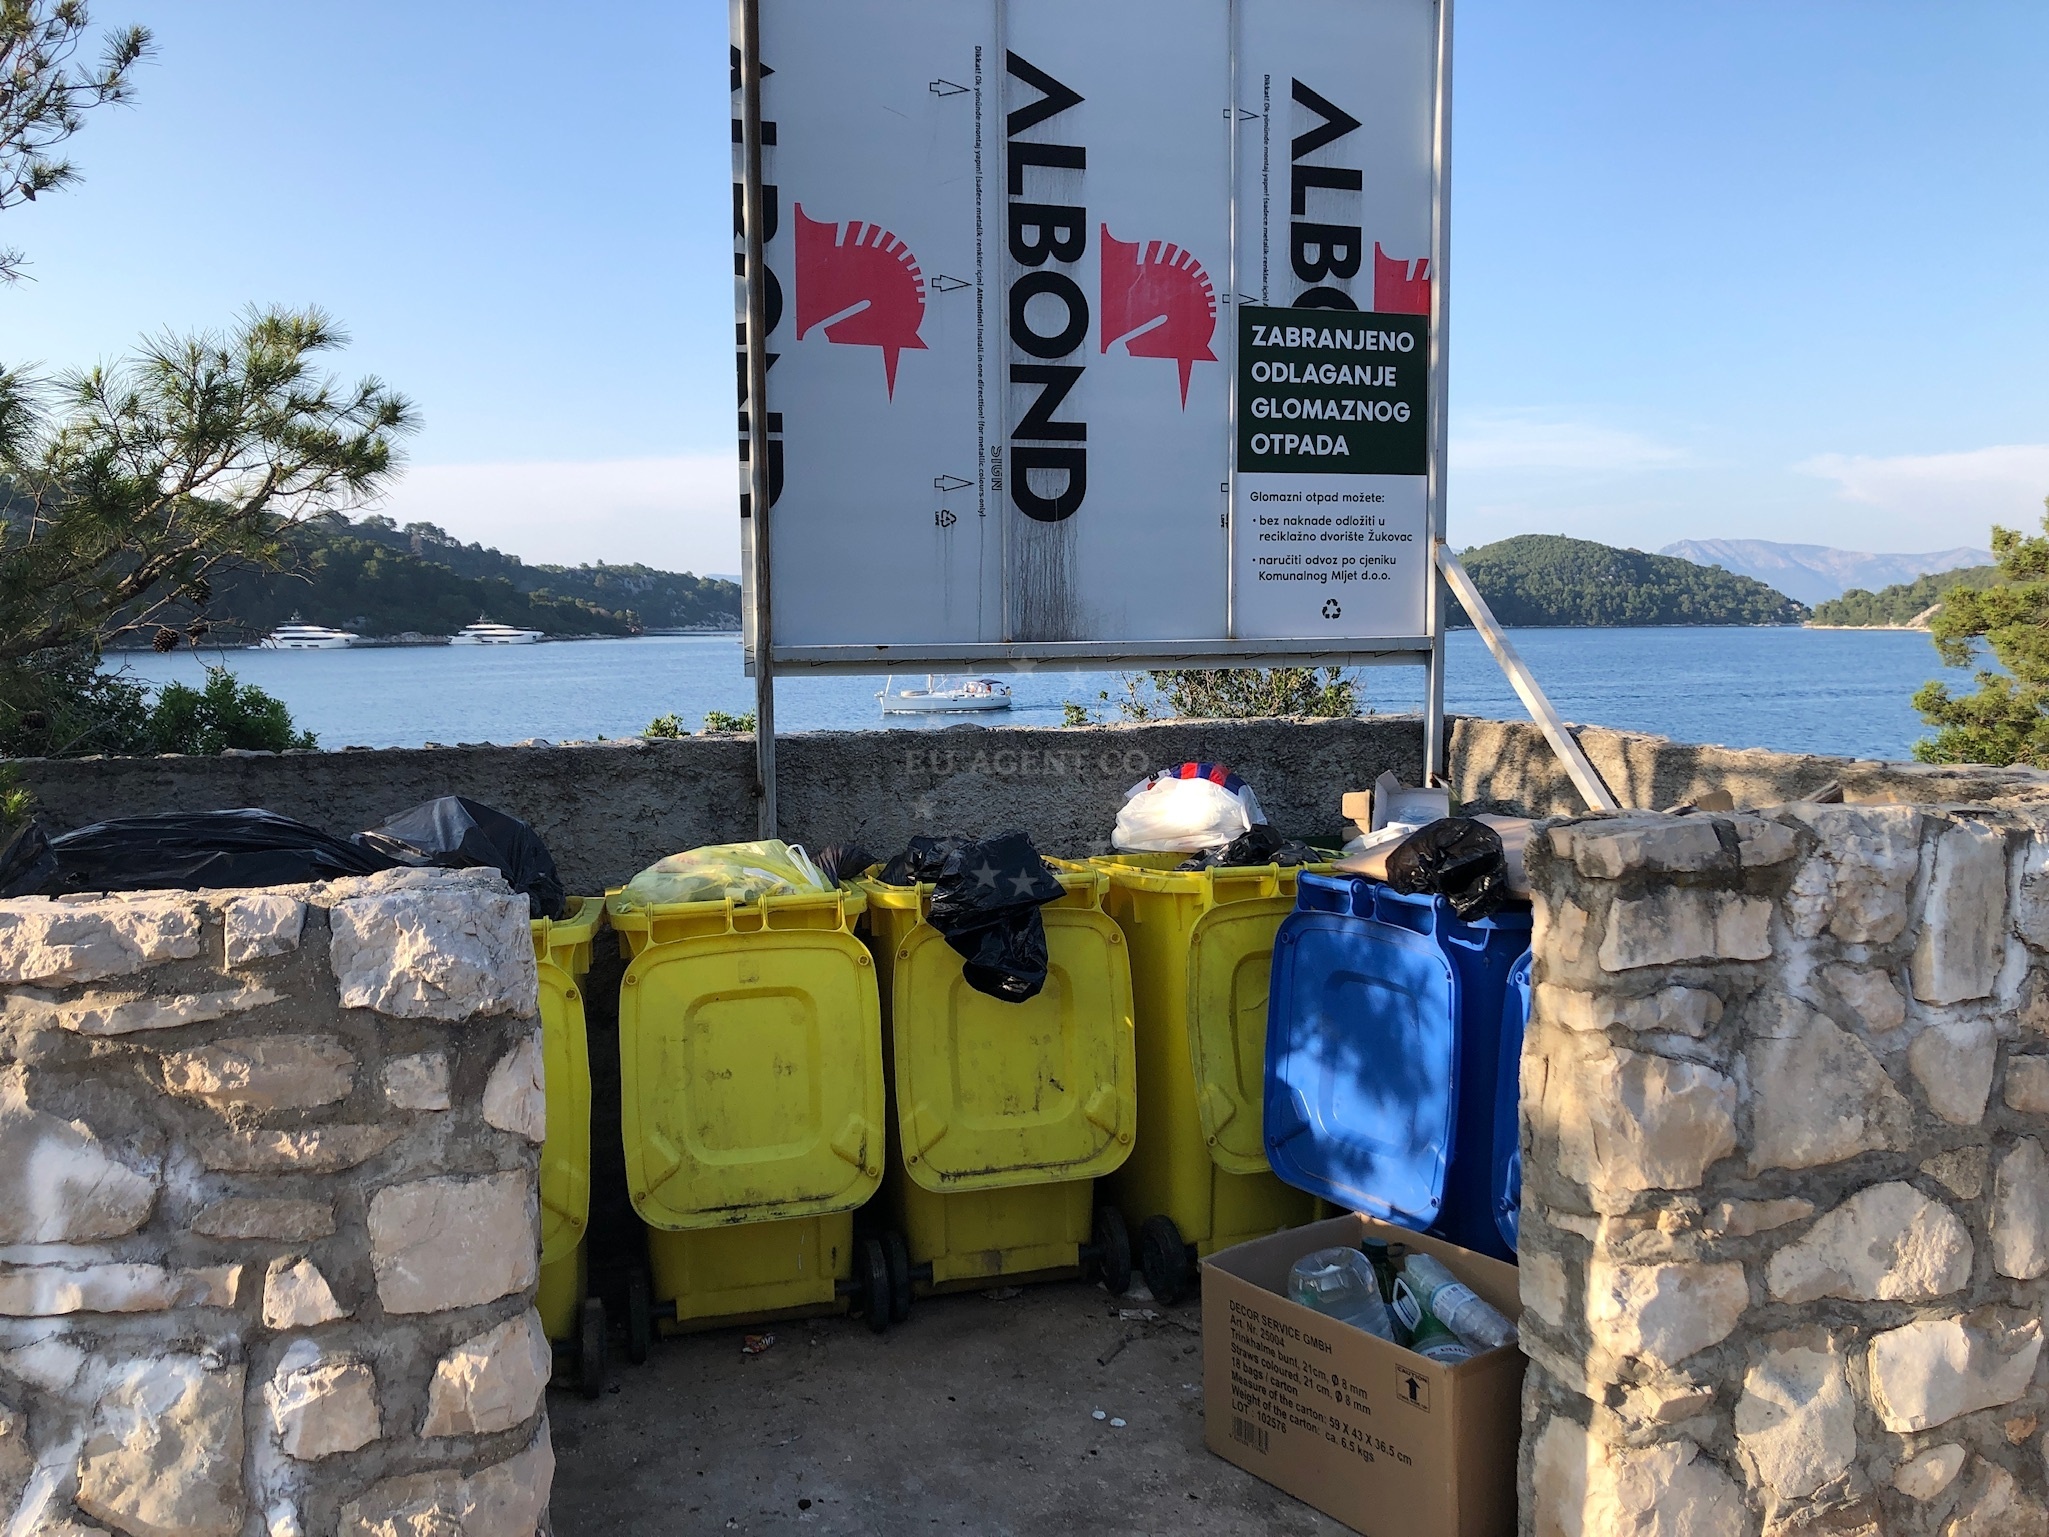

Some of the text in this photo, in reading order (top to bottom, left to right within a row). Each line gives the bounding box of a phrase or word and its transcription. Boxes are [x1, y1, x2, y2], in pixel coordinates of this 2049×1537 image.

[974, 122, 982, 149] montaj
[1291, 77, 1362, 311] ALB
[1006, 49, 1089, 522] ALBOND
[1251, 325, 1415, 352] ZABRANJENO
[1251, 361, 1397, 387] ODLAGANJE
[1251, 397, 1411, 422] GLOMAZNOG
[1250, 433, 1350, 456] OTPADA
[991, 445, 1002, 491] SIGN
[1250, 491, 1385, 505] Glomazni otpad možete:
[1259, 515, 1385, 526] bez naknade odložiti u
[1259, 529, 1413, 542] reciklažno dvorište Žukovac
[1259, 554, 1397, 568] naručiti odvoz po cjeniku
[1258, 570, 1391, 584] Komunalnog Mljet d.o.o.
[1229, 1299, 1332, 1355] DECOR SERVICE GMBH
[1246, 1321, 1259, 1336] Nr.
[1260, 1327, 1286, 1348] 25004
[1230, 1327, 1276, 1358] Trinkhalme
[1341, 1378, 1348, 1390] 8
[1349, 1384, 1368, 1400] mm
[1231, 1356, 1241, 1369] 18
[1242, 1361, 1264, 1381] bags
[1270, 1376, 1298, 1397] carton
[1231, 1342, 1259, 1364] Straws
[1303, 1375, 1313, 1389] 21
[1345, 1394, 1351, 1407] 8
[1353, 1400, 1371, 1416] mm
[1231, 1397, 1250, 1415] LOT
[1257, 1411, 1287, 1434] 102576
[1231, 1370, 1412, 1467] Measure of the carton: 59 X 43 X 36.5 cm
[1231, 1383, 1261, 1408] Weight
[1262, 1400, 1272, 1413] of
[1273, 1404, 1288, 1420] the
[1325, 1430, 1339, 1445] ca.
[1341, 1437, 1355, 1453] 6.5
[1357, 1443, 1375, 1463] kgs
